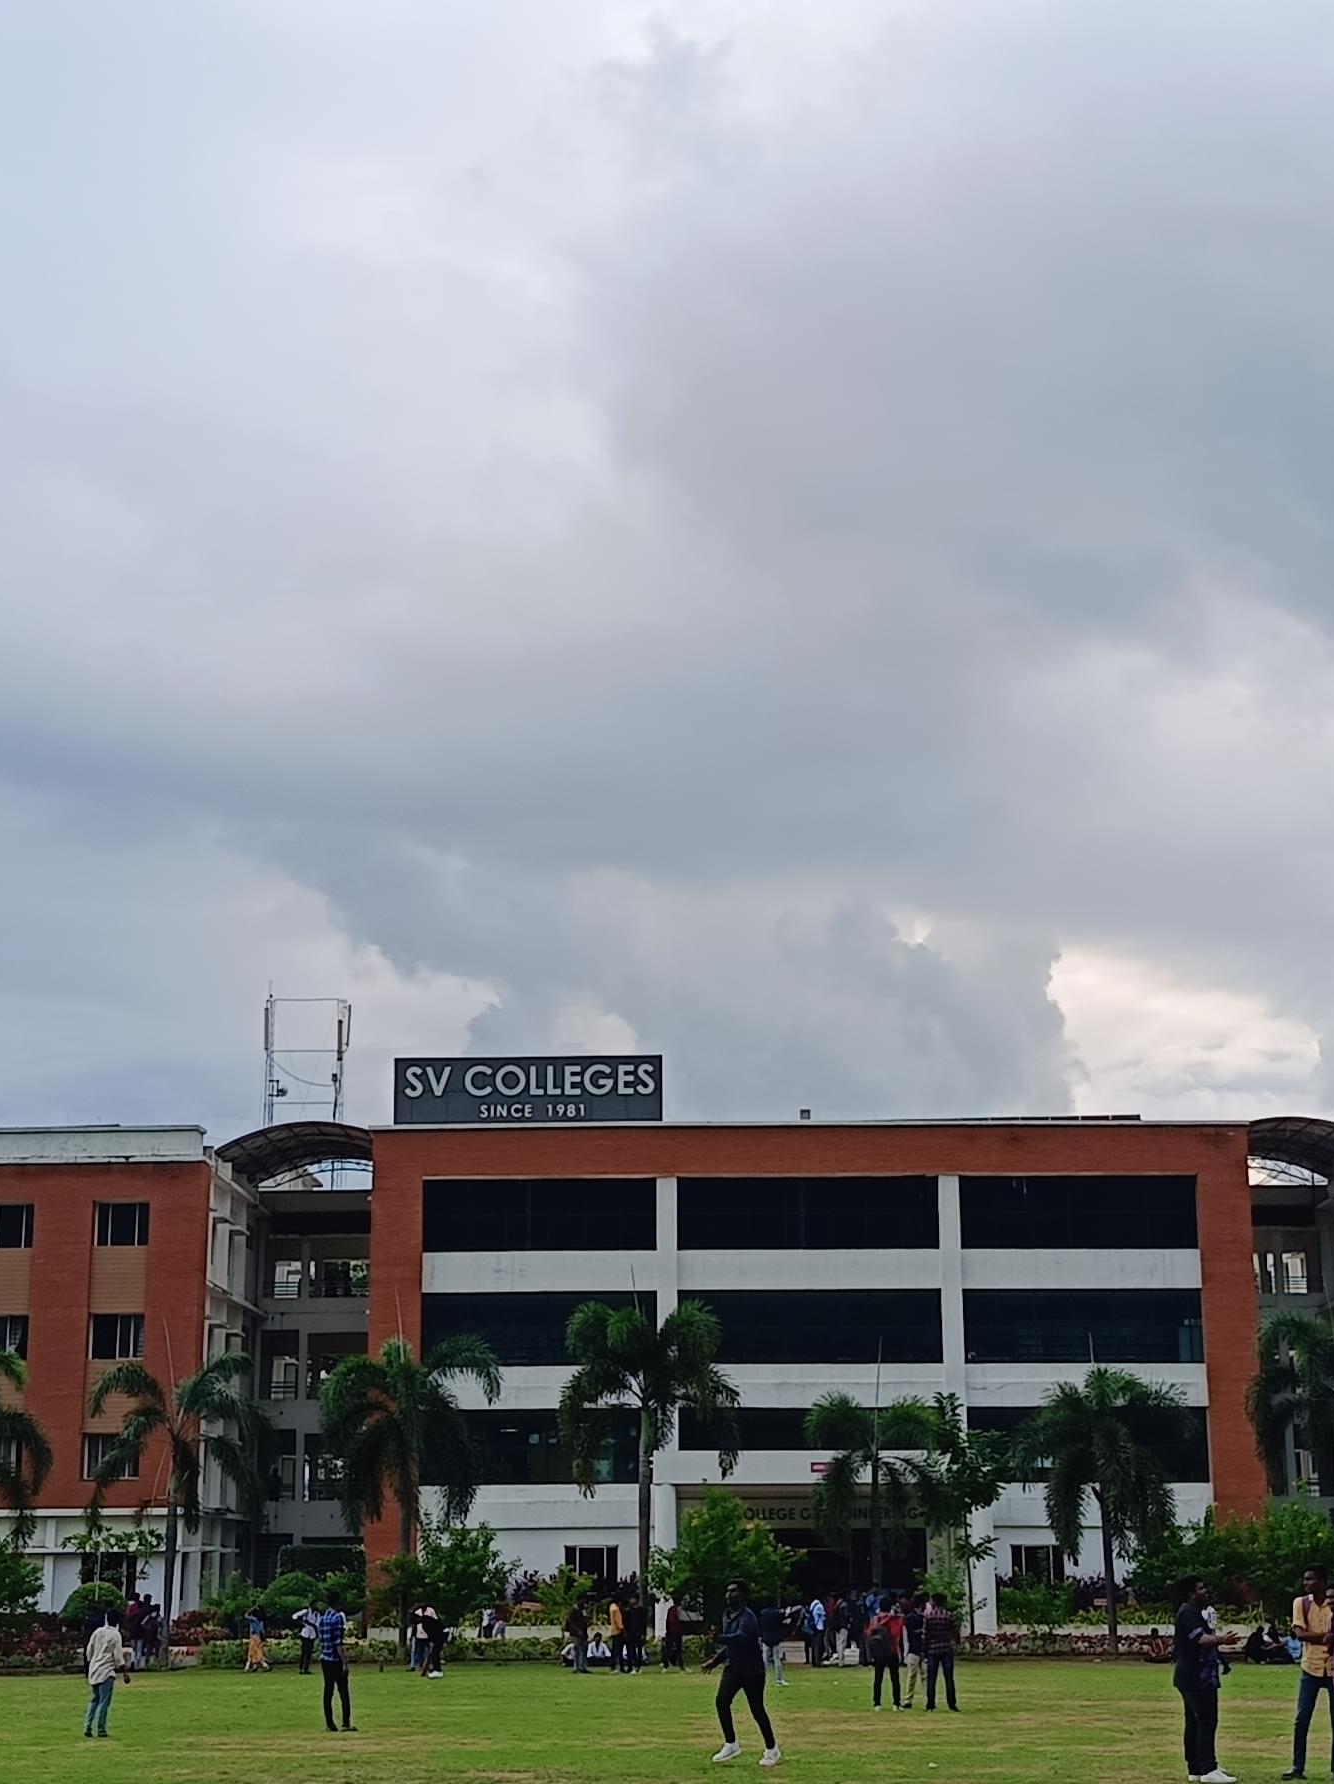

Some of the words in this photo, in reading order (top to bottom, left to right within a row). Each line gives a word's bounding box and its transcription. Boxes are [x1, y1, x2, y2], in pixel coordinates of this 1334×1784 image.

[404, 1066, 452, 1098] SV
[464, 1063, 655, 1097] COLLEGES
[479, 1104, 533, 1118] SINCE
[546, 1103, 586, 1117] 1981
[742, 1507, 795, 1521] OLLEGE
